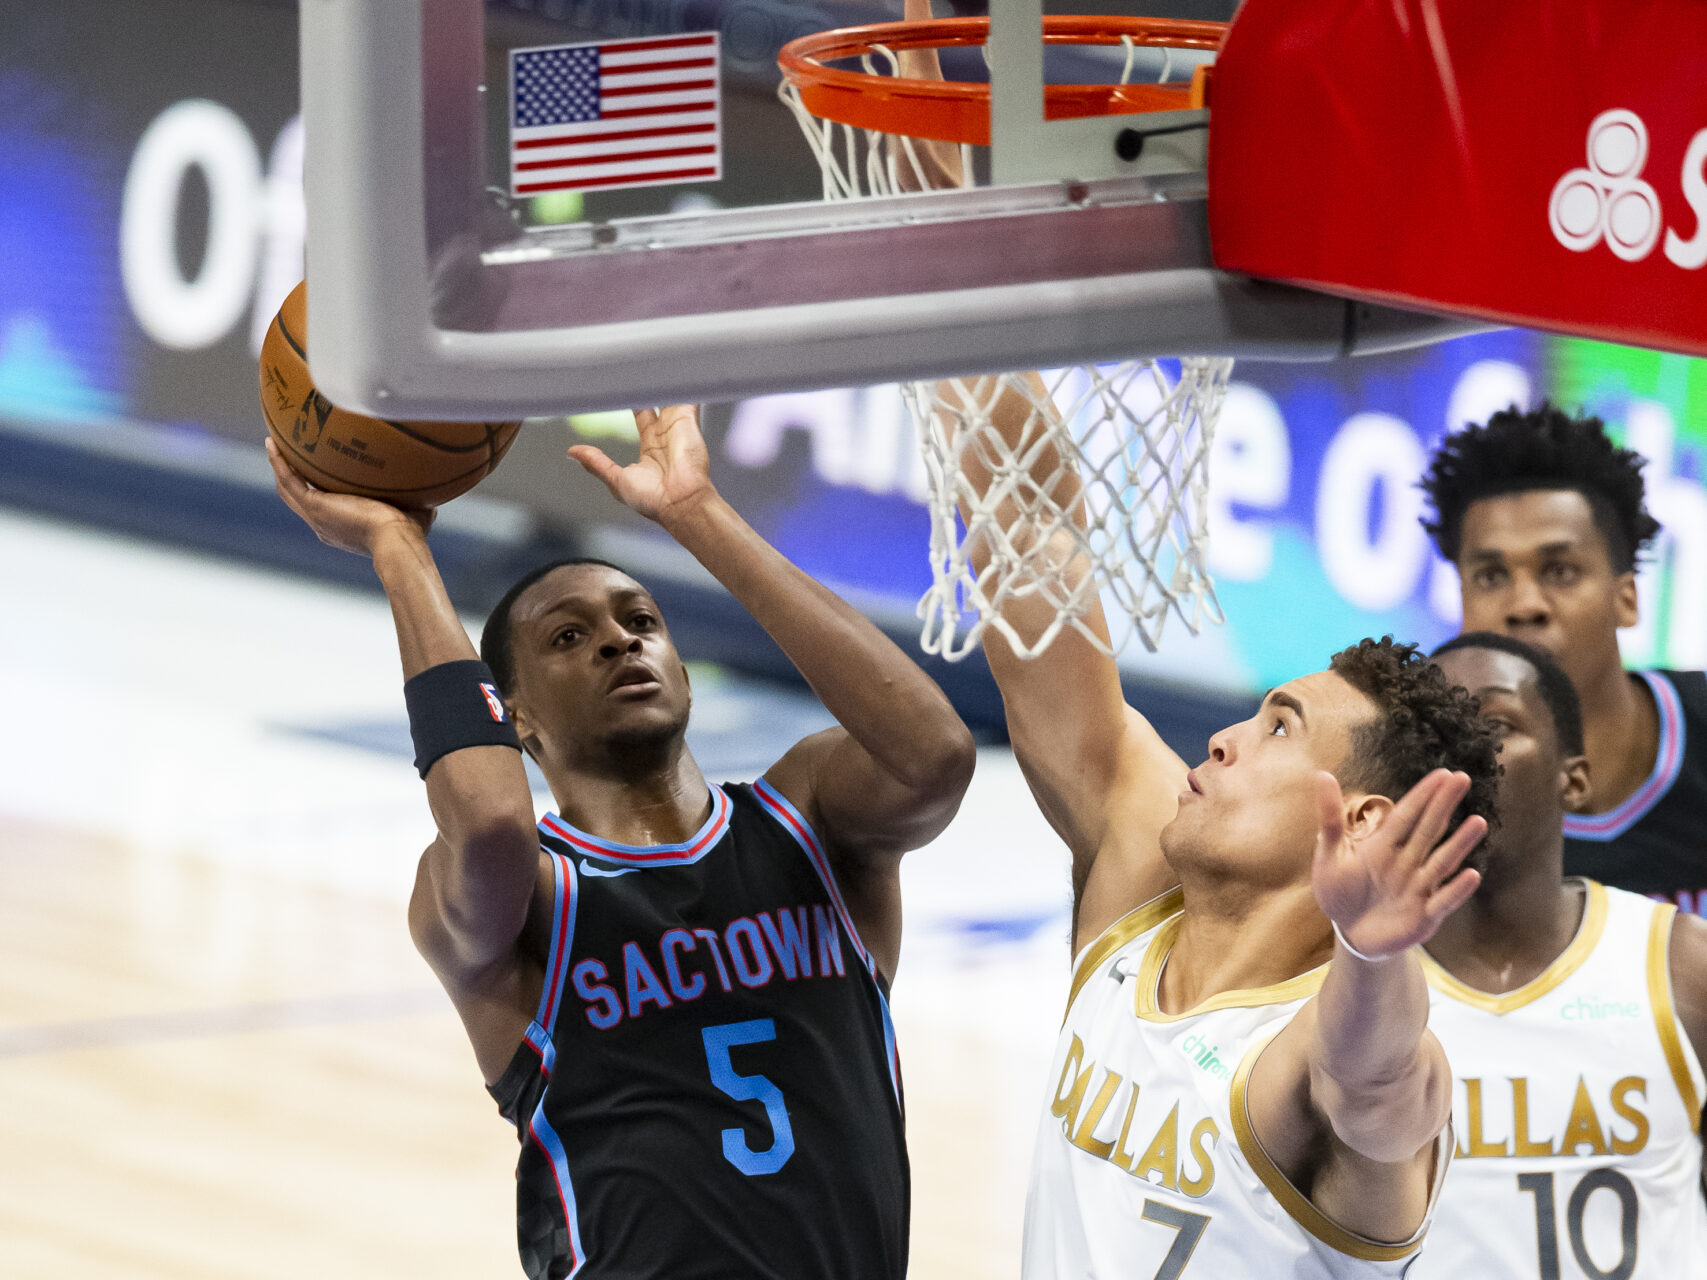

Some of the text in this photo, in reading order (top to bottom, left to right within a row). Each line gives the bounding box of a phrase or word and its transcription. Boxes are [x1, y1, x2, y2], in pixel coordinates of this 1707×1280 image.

[572, 905, 846, 1030] SACTOWN
[1561, 996, 1640, 1020] chime
[701, 1018, 795, 1176] 5
[1051, 1030, 1220, 1198] DALLAS
[1453, 1073, 1650, 1158] LLAS
